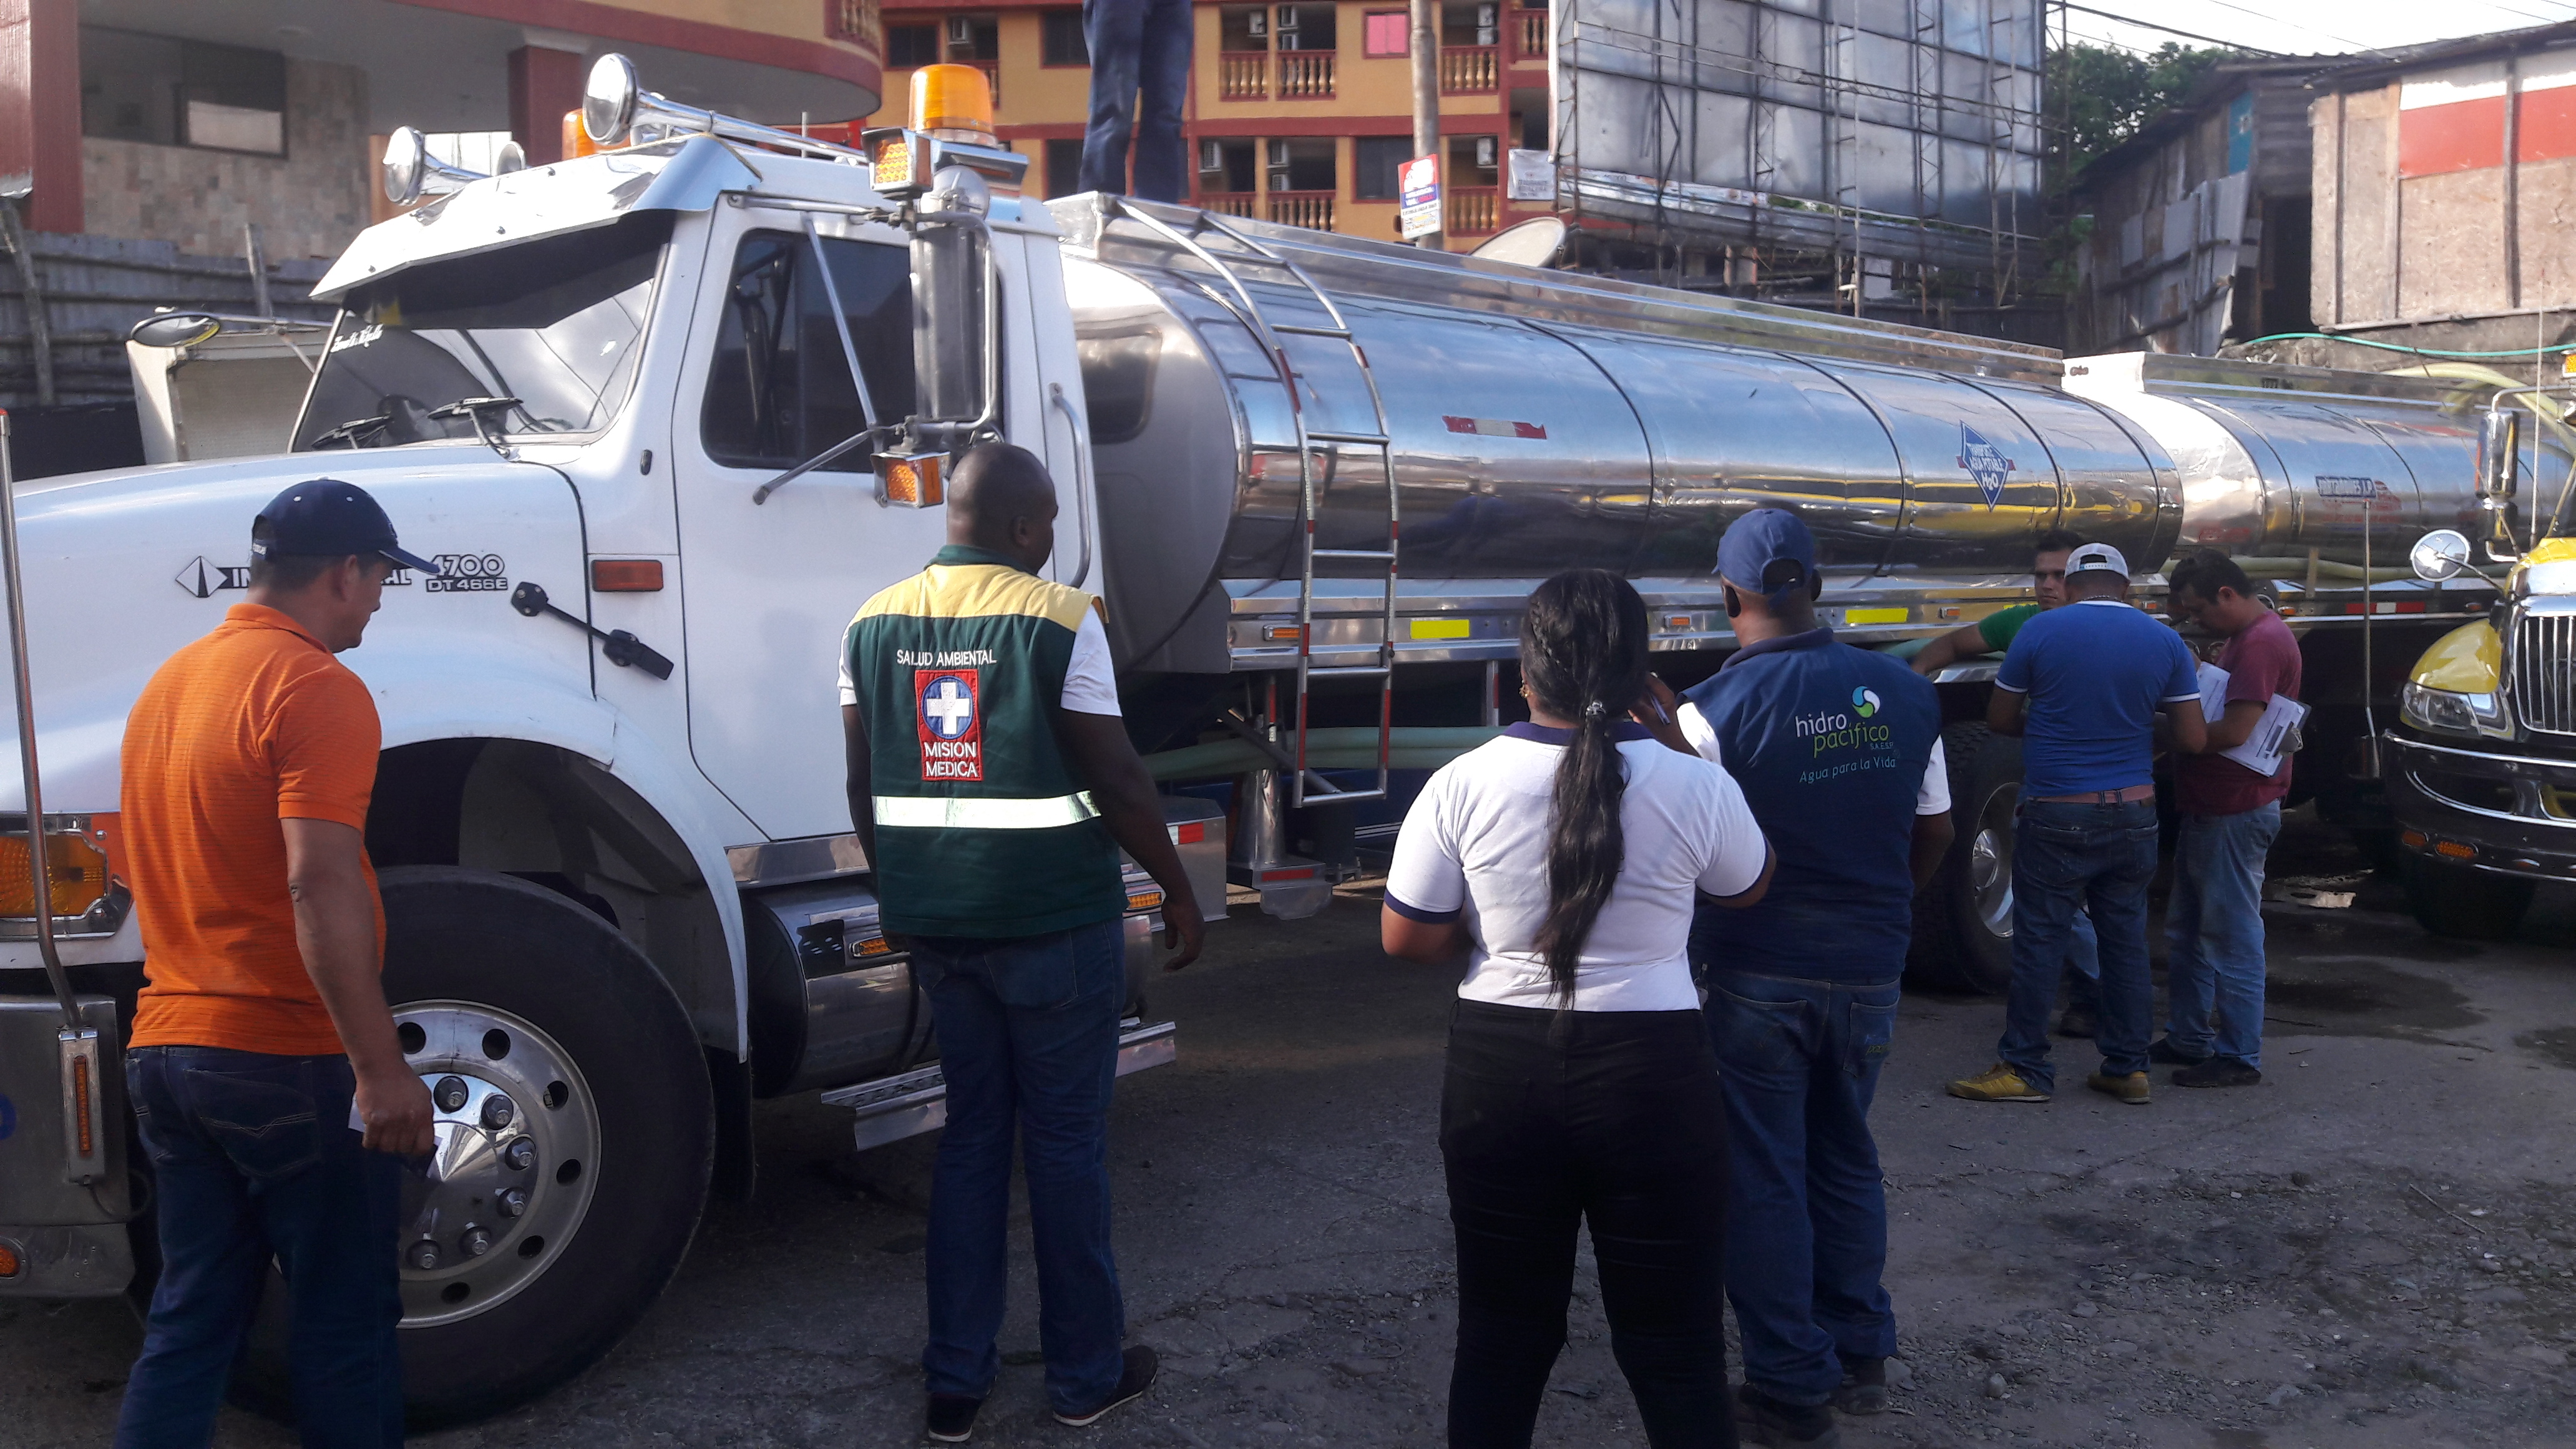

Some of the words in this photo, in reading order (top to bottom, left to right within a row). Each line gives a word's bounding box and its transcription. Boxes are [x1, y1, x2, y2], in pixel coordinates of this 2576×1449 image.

[432, 554, 505, 577] 4700
[427, 579, 454, 591] DT
[456, 578, 507, 590] 466E
[897, 649, 933, 666] SALUD
[936, 649, 998, 666] AMBIENTAL
[1795, 711, 1847, 738] hidro
[924, 741, 977, 758] MISION
[925, 761, 978, 778] MEDICA
[1799, 771, 1828, 784] Agua
[1832, 762, 1858, 779] para
[1860, 758, 1870, 770] la
[1873, 756, 1896, 769] Vida
